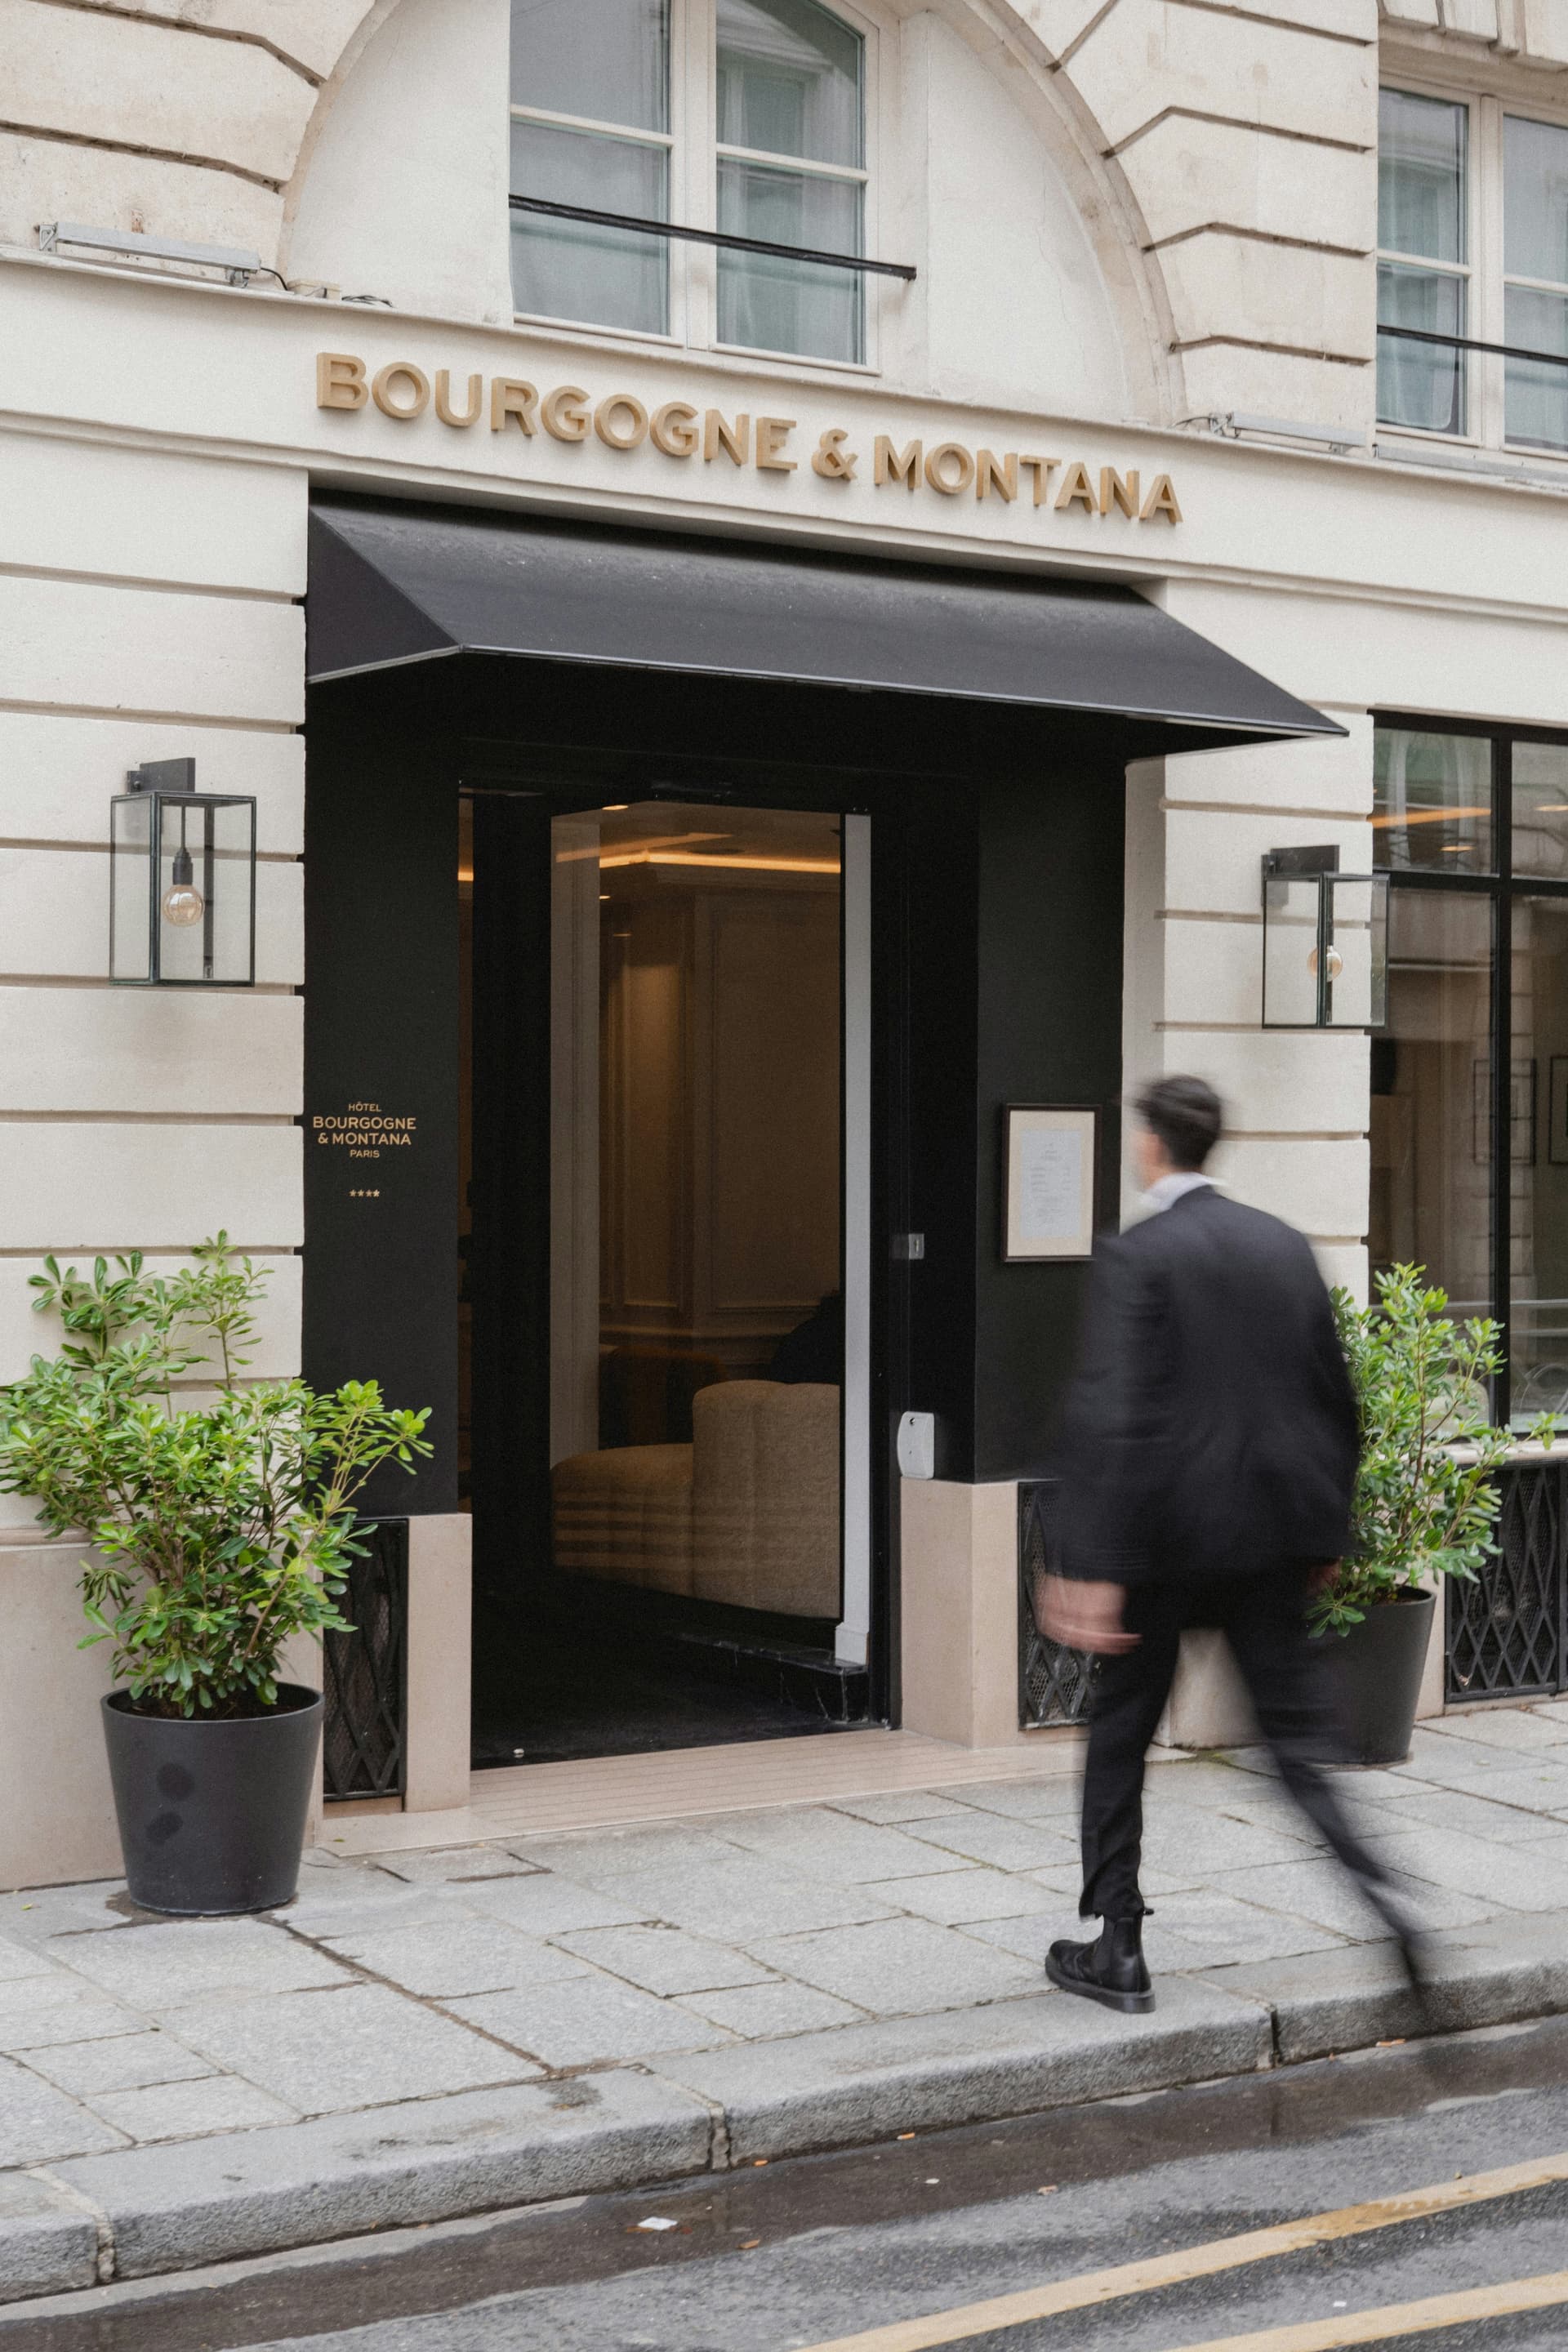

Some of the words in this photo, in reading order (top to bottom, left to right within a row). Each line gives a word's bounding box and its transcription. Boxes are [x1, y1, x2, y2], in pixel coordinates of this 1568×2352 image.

[316, 352, 798, 472] BOURGOGNE
[811, 428, 859, 481] &
[874, 434, 1183, 524] MONTANA
[348, 1101, 381, 1111] HÔTEL
[313, 1116, 416, 1129] BOURGOGNE
[318, 1132, 328, 1143] &
[332, 1133, 412, 1145] MONTANA
[350, 1150, 380, 1158] PARIS
